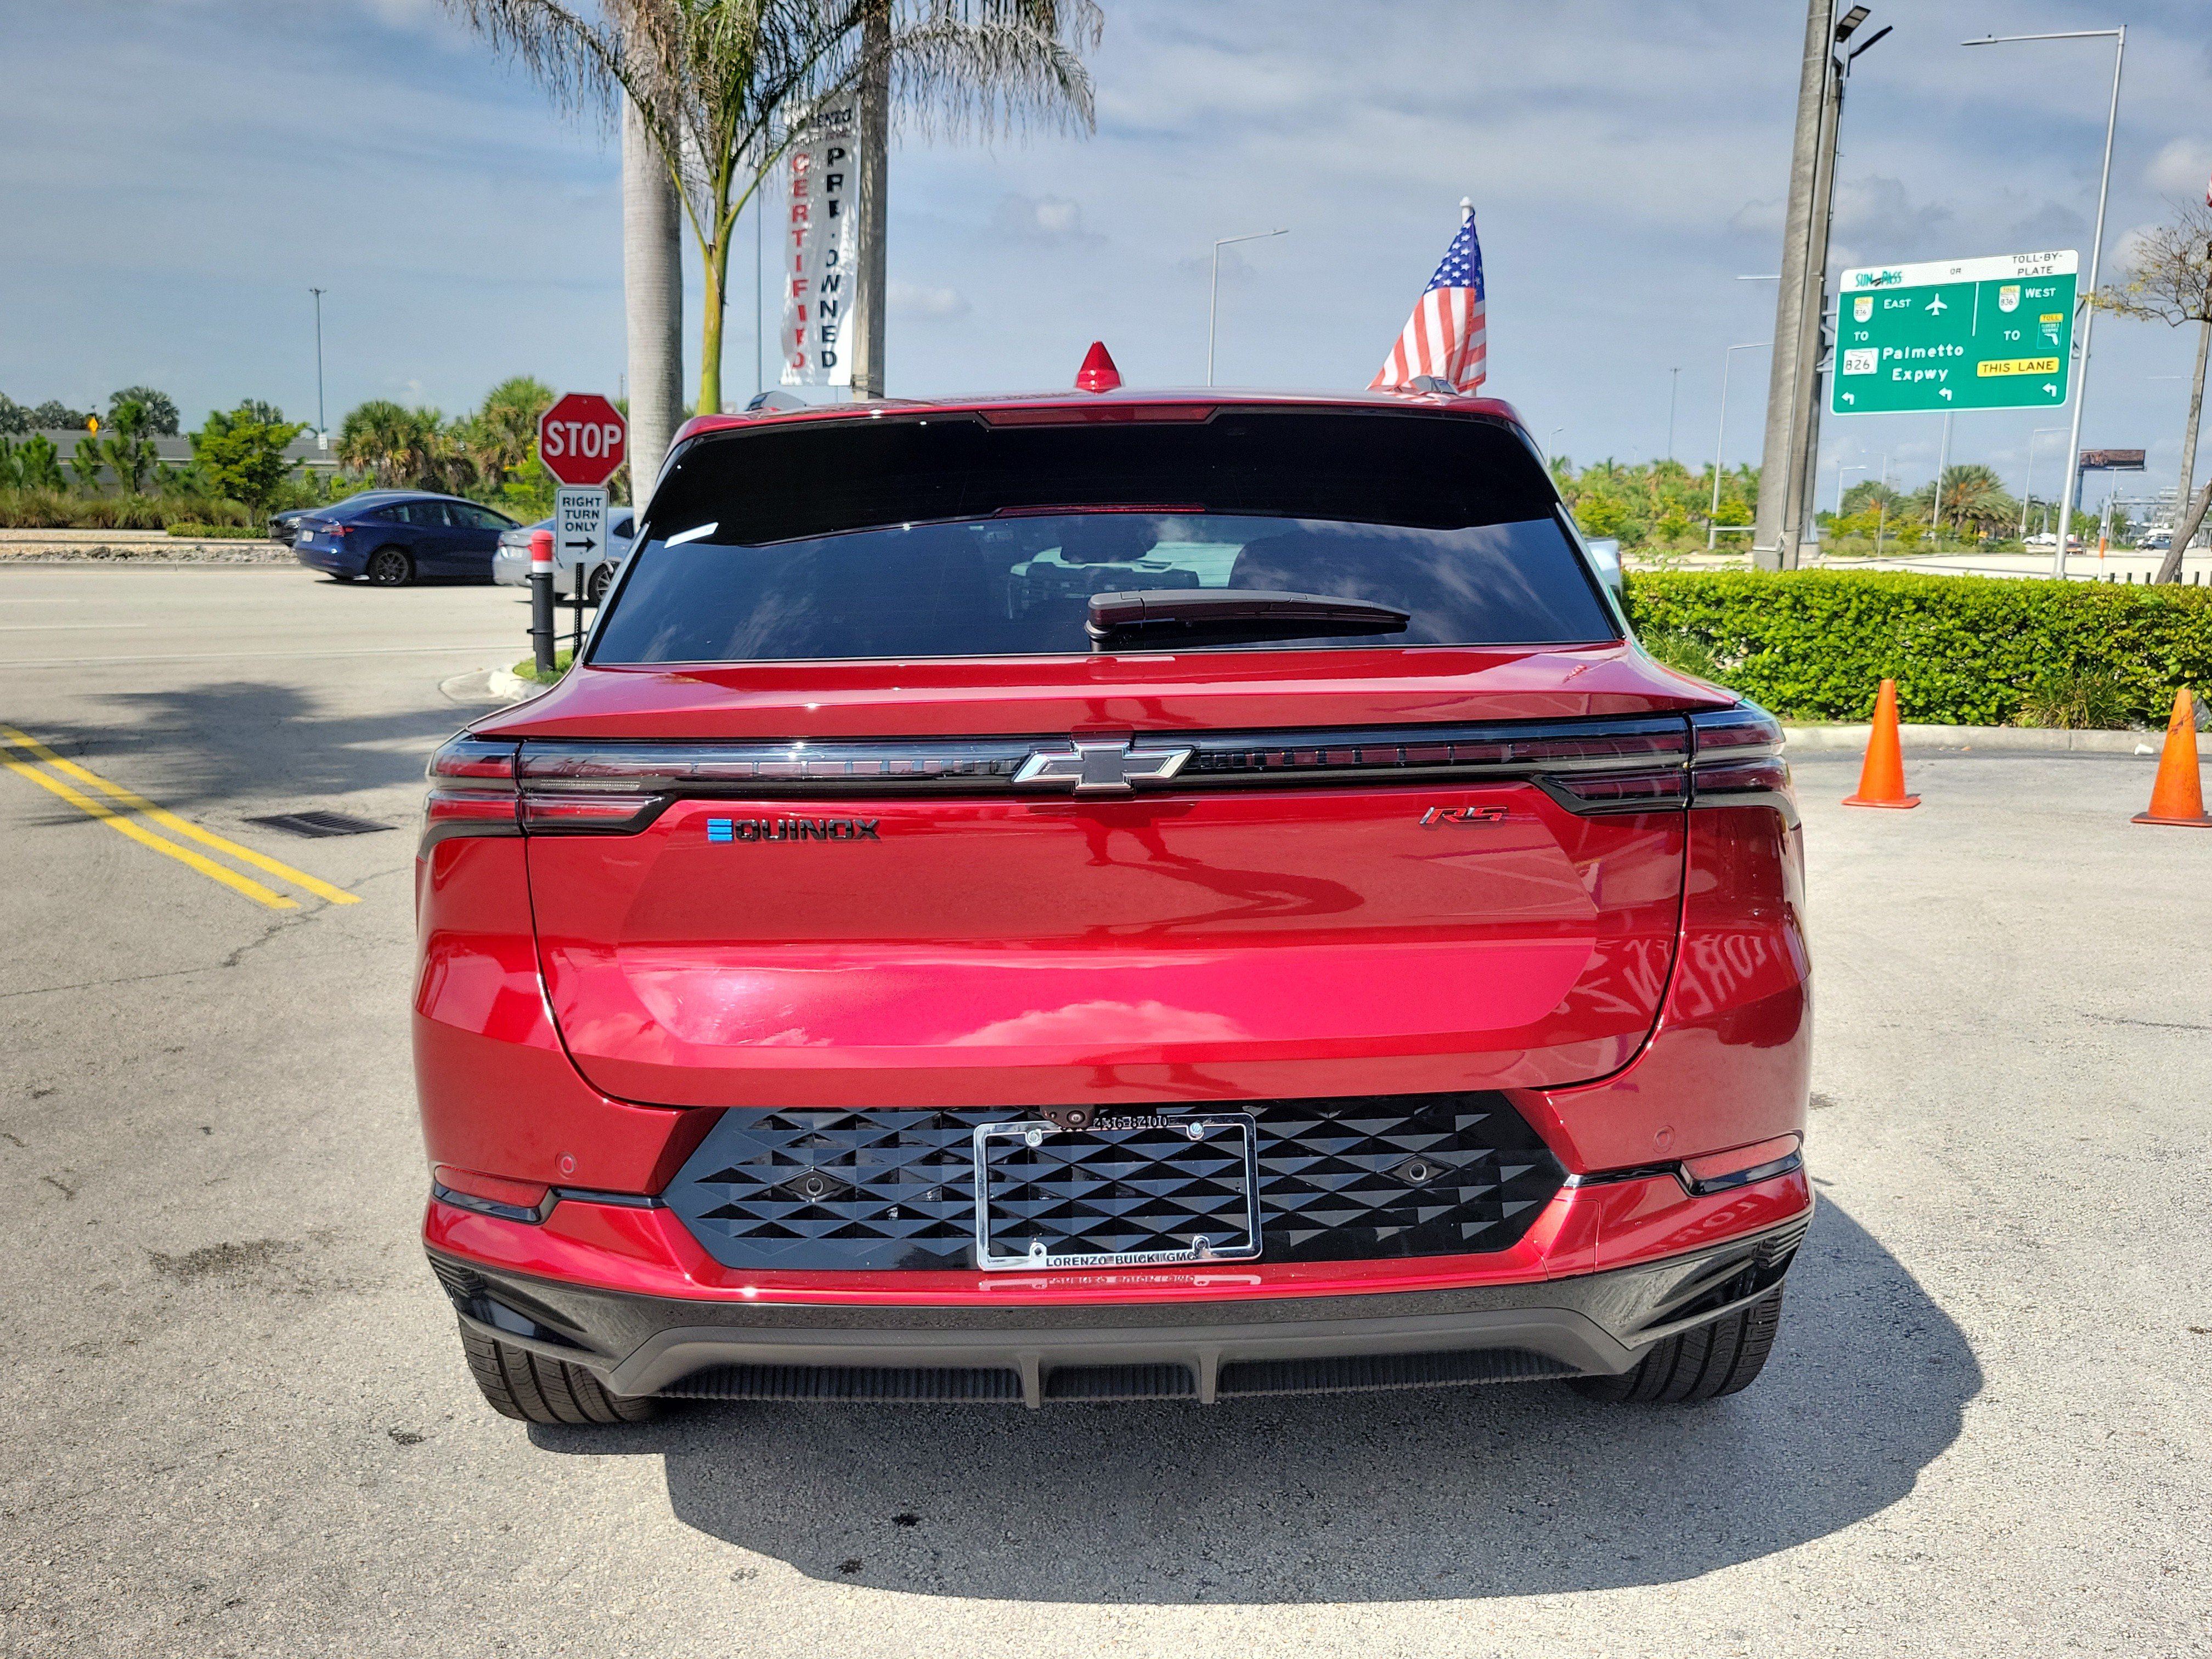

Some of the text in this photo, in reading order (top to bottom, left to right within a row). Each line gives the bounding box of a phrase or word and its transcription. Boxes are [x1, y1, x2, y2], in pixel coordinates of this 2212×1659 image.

[2018, 266, 2053, 275] PLATE
[2025, 287, 2057, 298] WEST
[1883, 298, 1912, 309] EAST
[1854, 330, 1870, 341] TO
[2003, 330, 2021, 341] TO
[1882, 343, 1964, 360] Palmetto
[1845, 359, 1870, 370] 826
[1982, 360, 2055, 373] THIS LANE
[1892, 368, 1949, 383] Expwy
[544, 420, 623, 459] STOP
[562, 496, 602, 507] RIGHT
[565, 510, 600, 520] TURN
[565, 522, 598, 532] ONLY
[1419, 806, 1508, 824] RS
[707, 819, 881, 842] EQUINOX
[1046, 1251, 1195, 1267] LORENZO BUICK GMC
